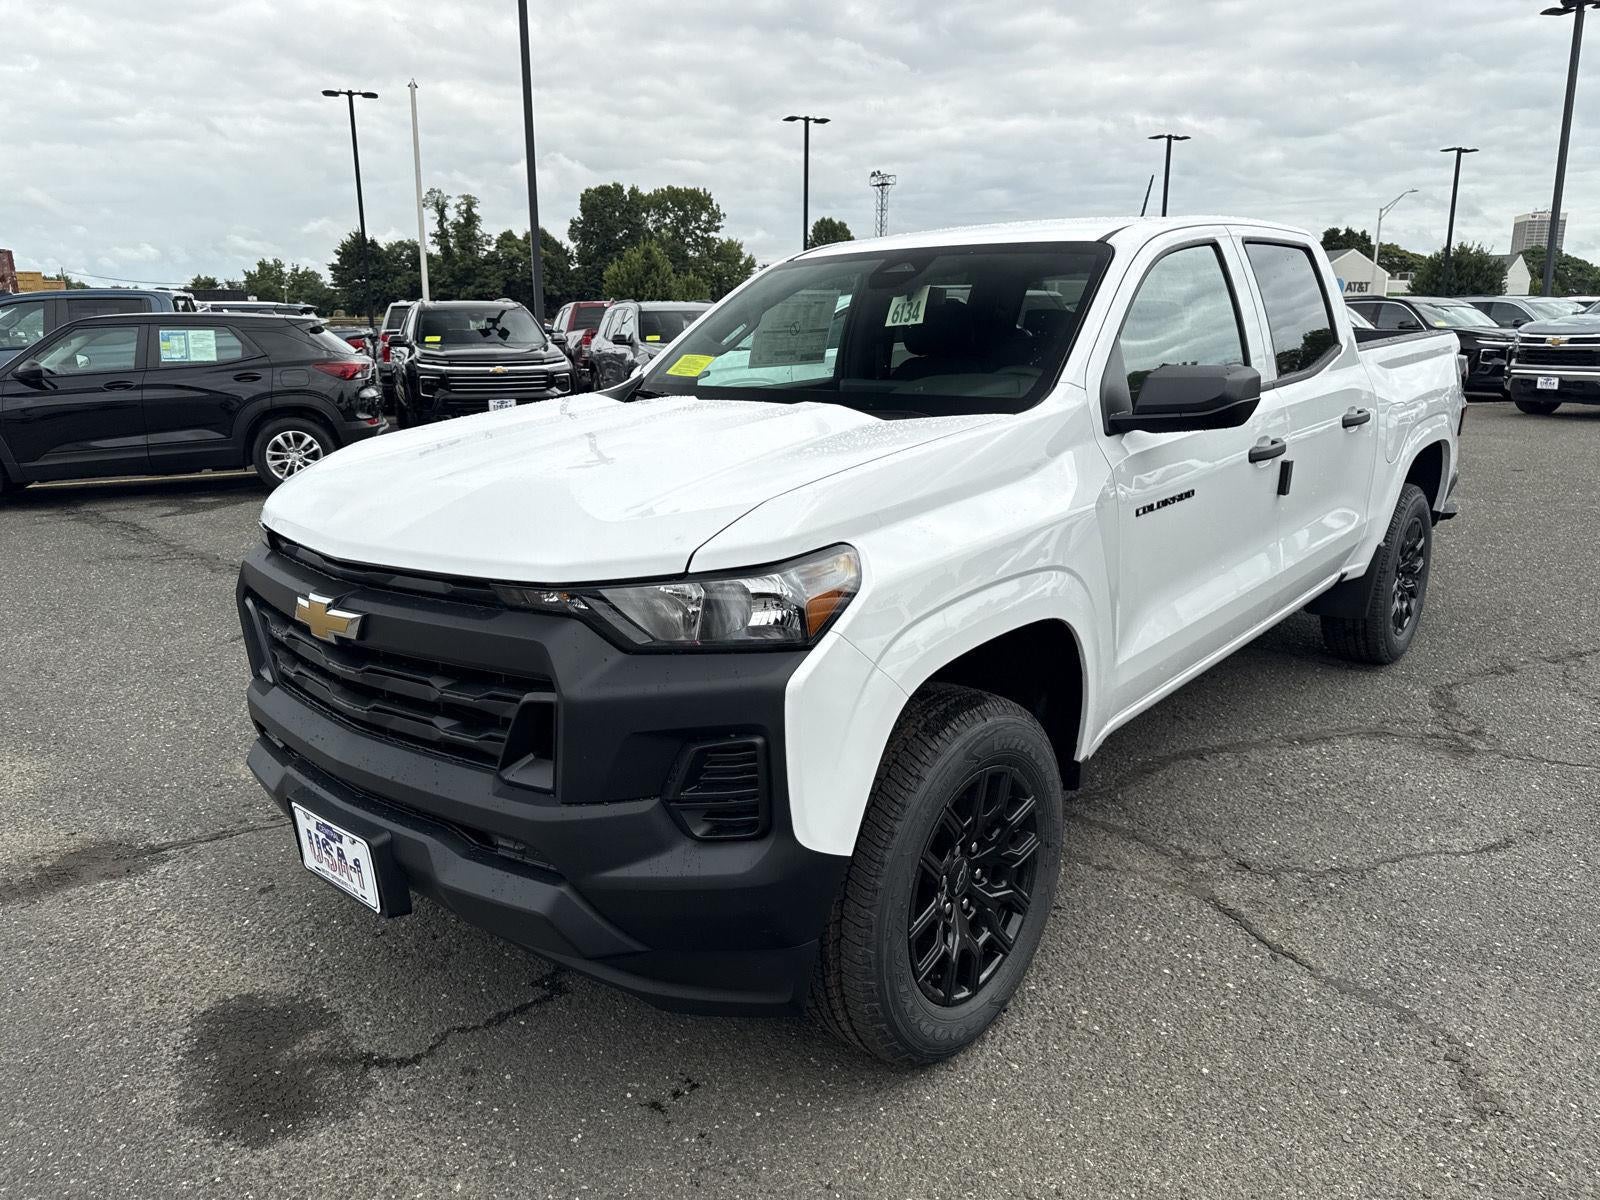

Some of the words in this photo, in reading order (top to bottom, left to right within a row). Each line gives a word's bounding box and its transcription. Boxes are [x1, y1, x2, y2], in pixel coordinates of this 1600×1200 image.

[1345, 281, 1371, 292] AT&T
[891, 300, 921, 324] 6134
[1135, 489, 1195, 517] COLORADO
[306, 828, 365, 890] USA-1
